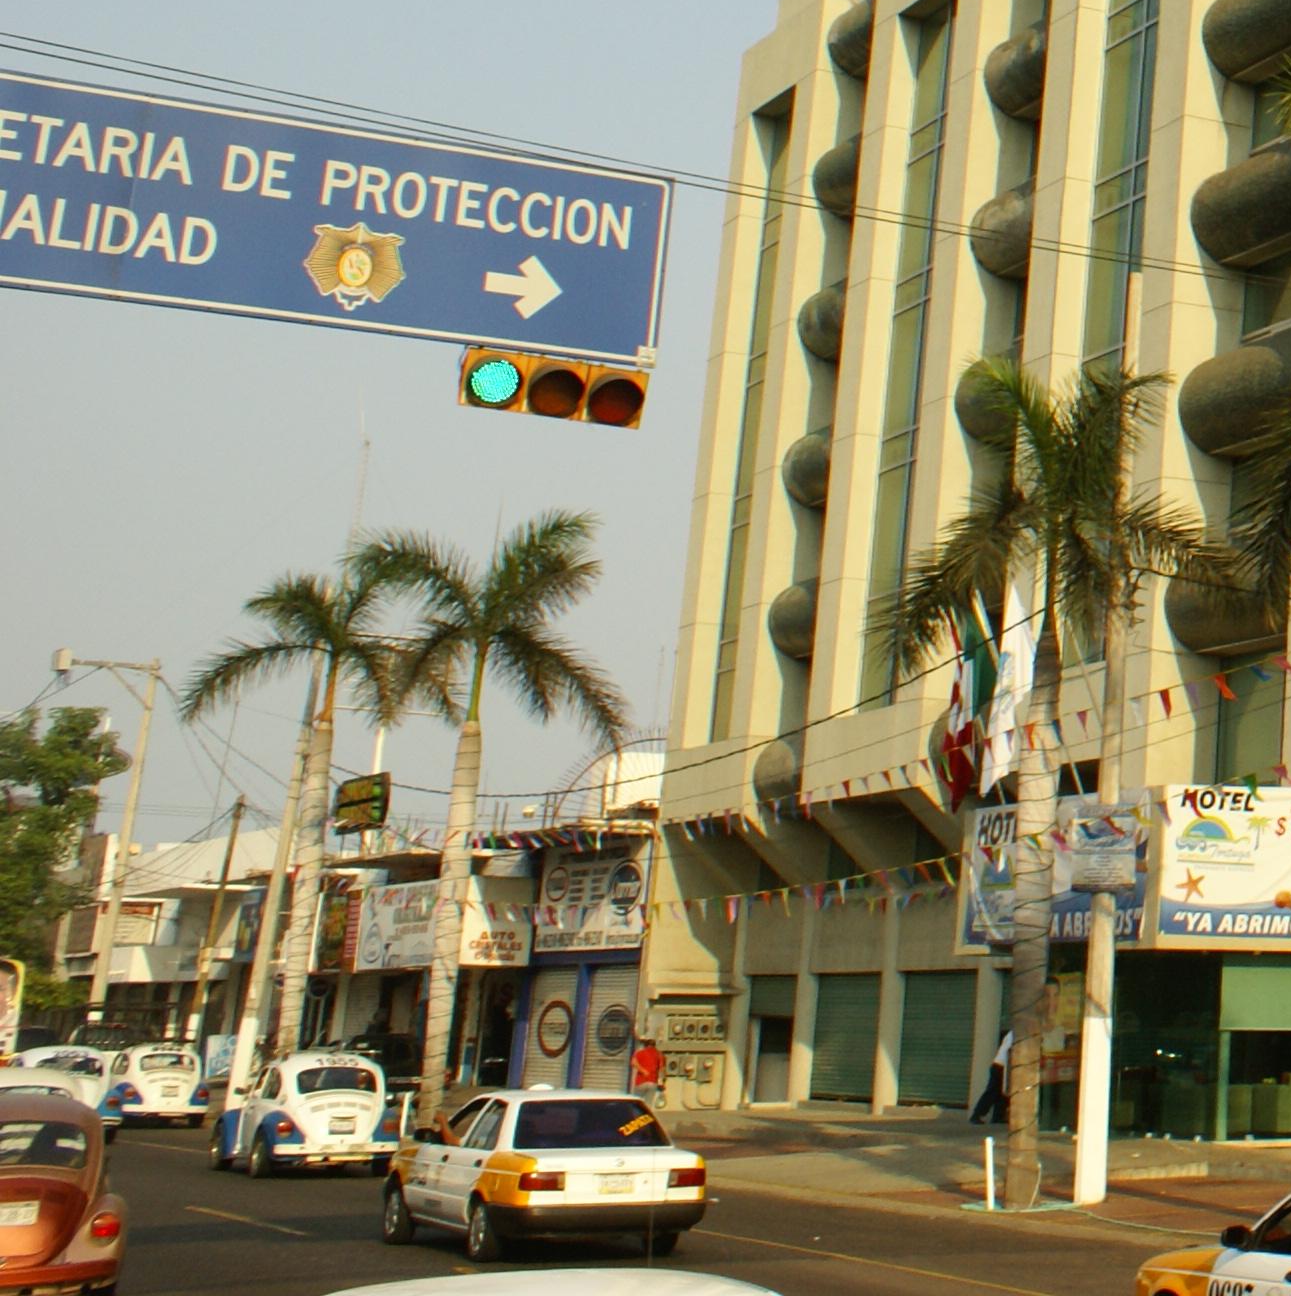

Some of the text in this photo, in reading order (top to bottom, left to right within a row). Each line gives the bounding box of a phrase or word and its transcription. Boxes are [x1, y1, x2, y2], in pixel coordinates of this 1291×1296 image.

[221, 144, 296, 200] DE
[319, 158, 633, 251] PROTECCION
[1180, 788, 1256, 813] HOTEL
[1274, 817, 1287, 837] $
